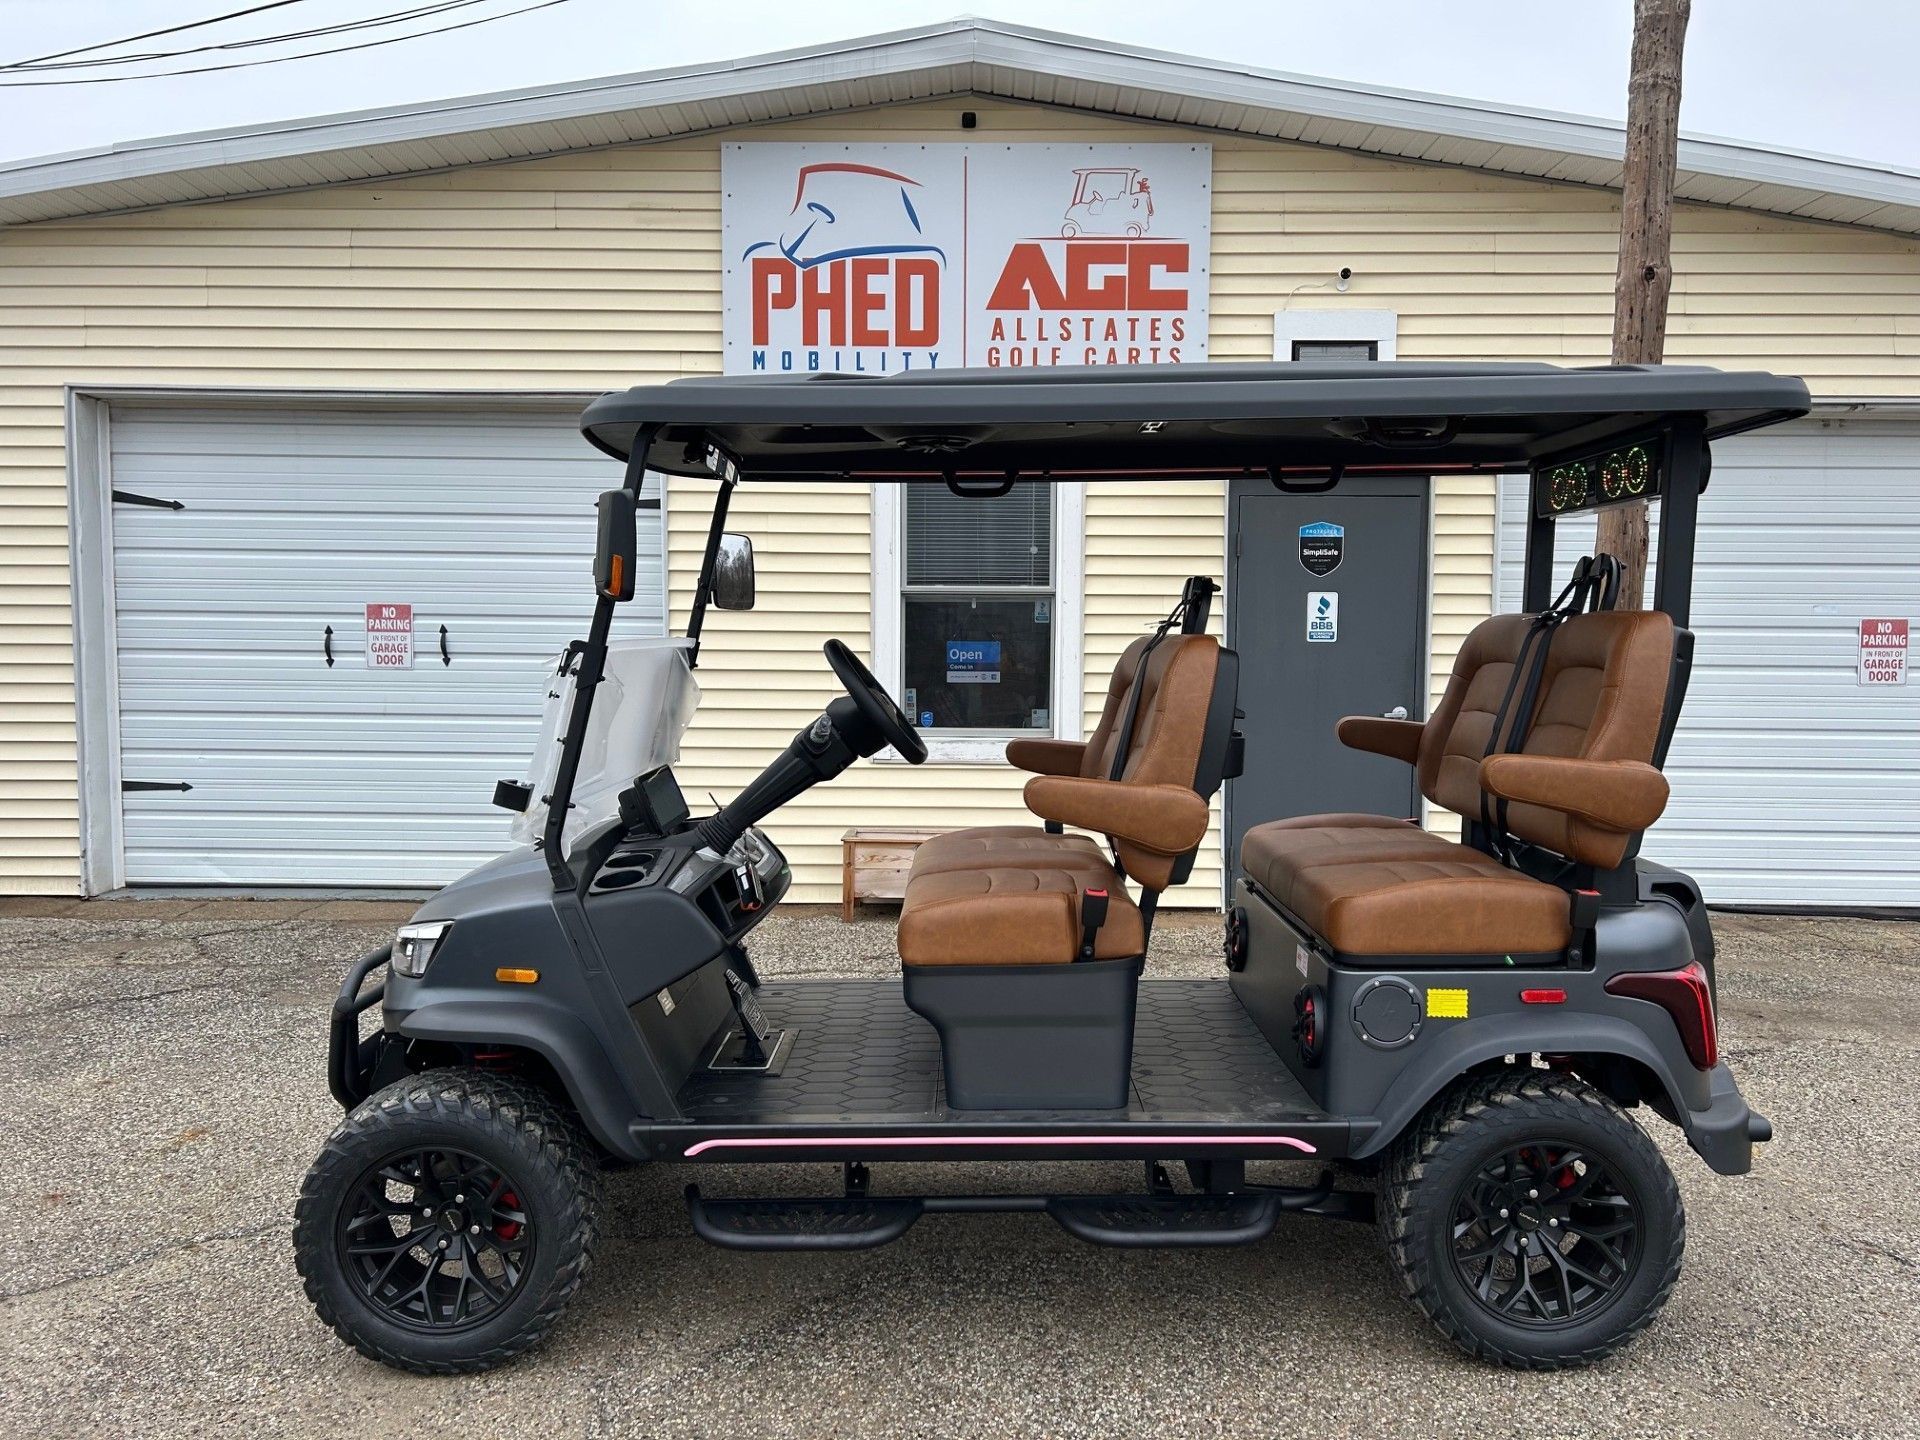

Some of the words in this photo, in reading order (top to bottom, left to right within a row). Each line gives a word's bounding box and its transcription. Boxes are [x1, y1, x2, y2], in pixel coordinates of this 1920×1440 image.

[986, 243, 1189, 311] AGC
[752, 258, 940, 347] PHED
[991, 317, 1185, 342] ALLSTATES
[752, 350, 939, 371] MOBILITY
[987, 347, 1062, 368] GOLF
[1085, 346, 1181, 366] CARTS
[1303, 548, 1339, 557] SimpliSafe
[382, 606, 396, 618] NO
[368, 619, 410, 630] PARKING
[1311, 621, 1333, 630] BBB
[1877, 622, 1893, 633] NO
[1862, 634, 1907, 646] PARKING
[371, 643, 408, 653] GARAGE
[376, 655, 404, 665] DOOR
[950, 648, 983, 662] Open
[1864, 659, 1904, 669] GARAGE
[1869, 671, 1898, 681] DOOR
